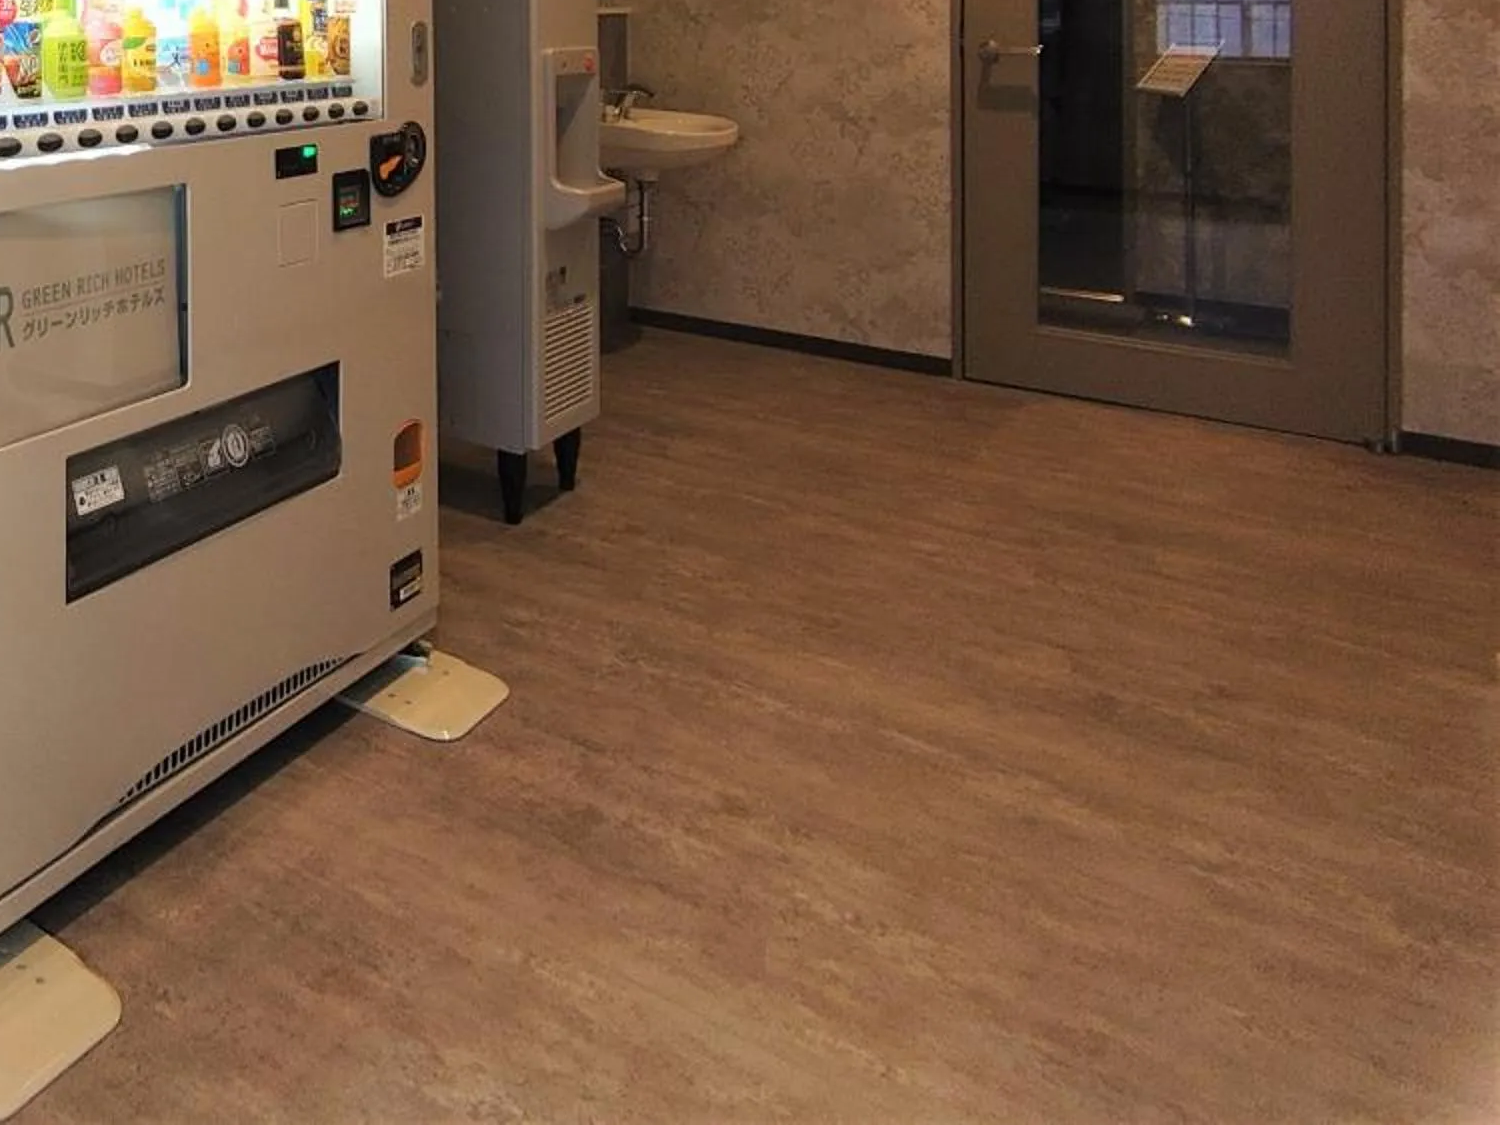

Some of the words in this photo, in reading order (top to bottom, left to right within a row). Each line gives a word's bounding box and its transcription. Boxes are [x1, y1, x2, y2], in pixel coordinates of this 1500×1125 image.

[21, 279, 72, 309] GREEN
[77, 272, 109, 295] RICH
[115, 258, 166, 285] HOTELS
[22, 286, 166, 342] グリーンリッチホテルズ
